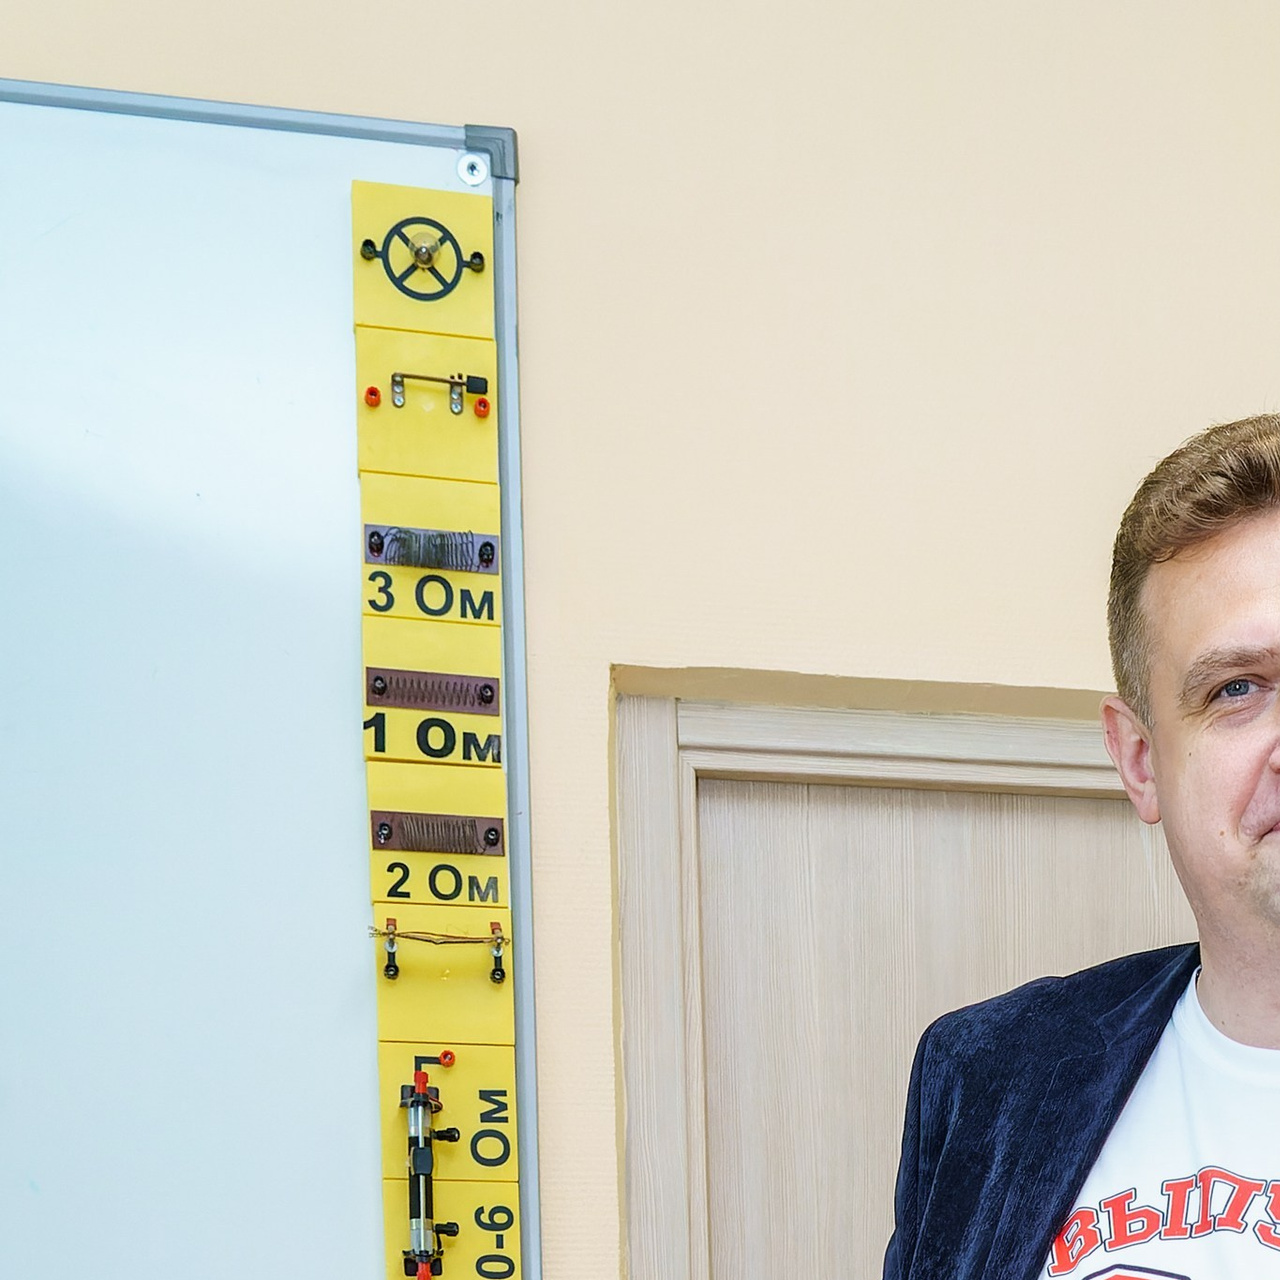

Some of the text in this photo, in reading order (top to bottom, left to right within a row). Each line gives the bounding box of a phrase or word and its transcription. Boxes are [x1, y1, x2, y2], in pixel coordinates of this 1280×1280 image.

[368, 571, 494, 620] 3 Ом
[363, 712, 502, 763] 1 Ом
[386, 862, 499, 903] 2 Ом
[470, 1090, 515, 1280] 0-6 Ом
